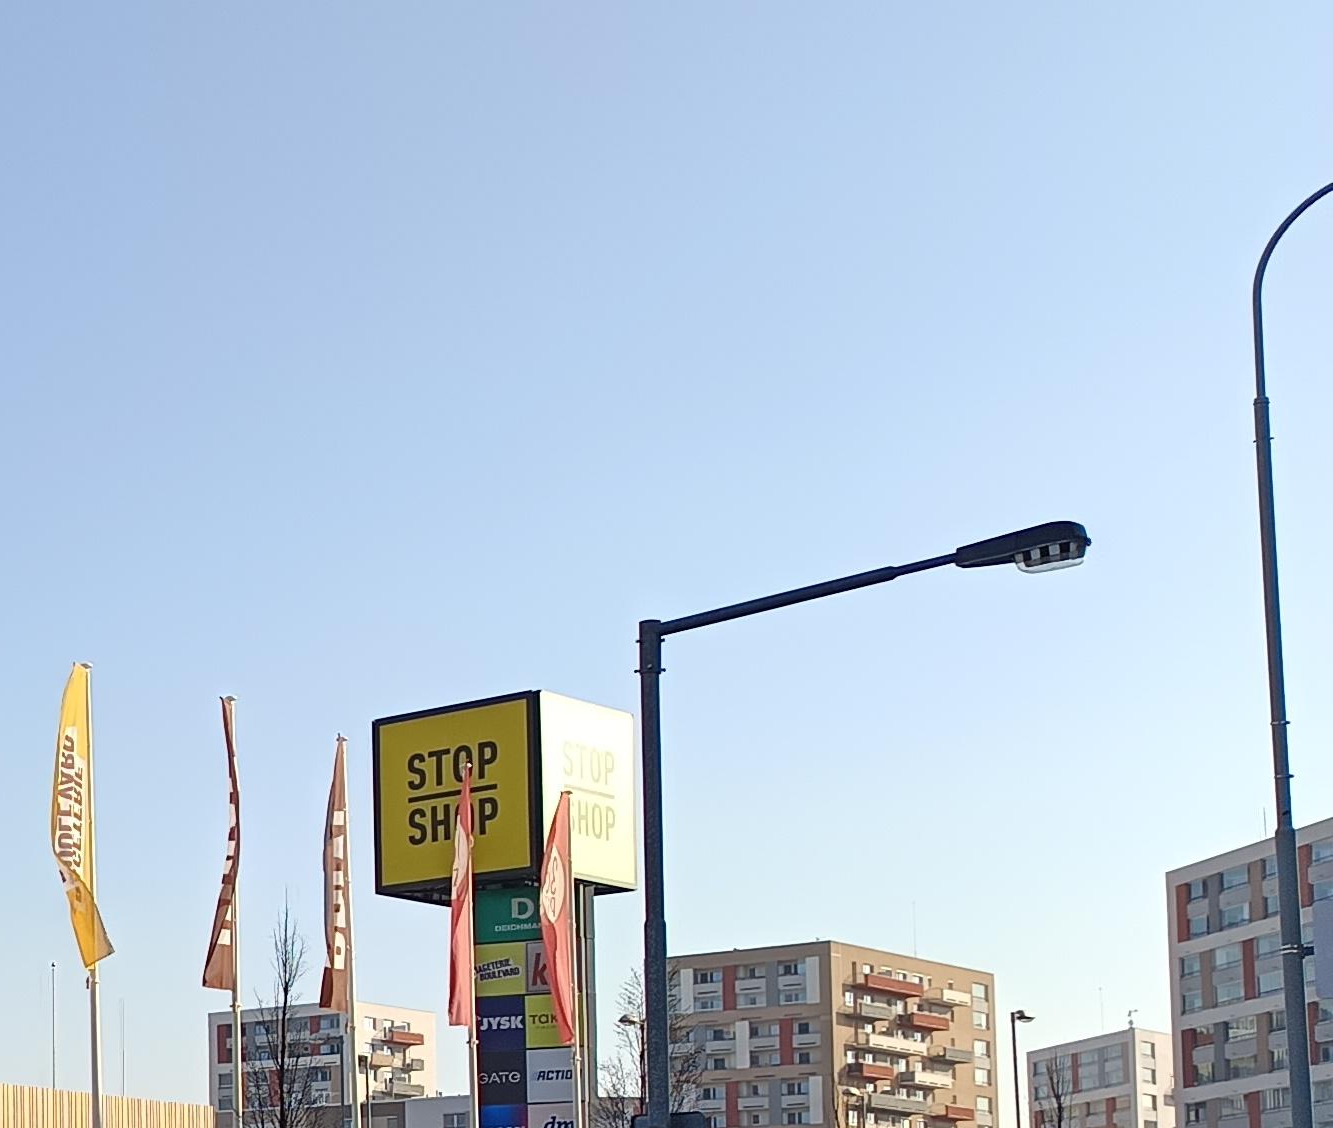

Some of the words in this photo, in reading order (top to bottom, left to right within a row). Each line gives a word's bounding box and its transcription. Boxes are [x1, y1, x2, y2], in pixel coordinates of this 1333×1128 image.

[406, 740, 499, 791] STOP
[563, 740, 615, 786] STOP
[511, 897, 535, 920] D
[480, 1015, 524, 1031] JYSK
